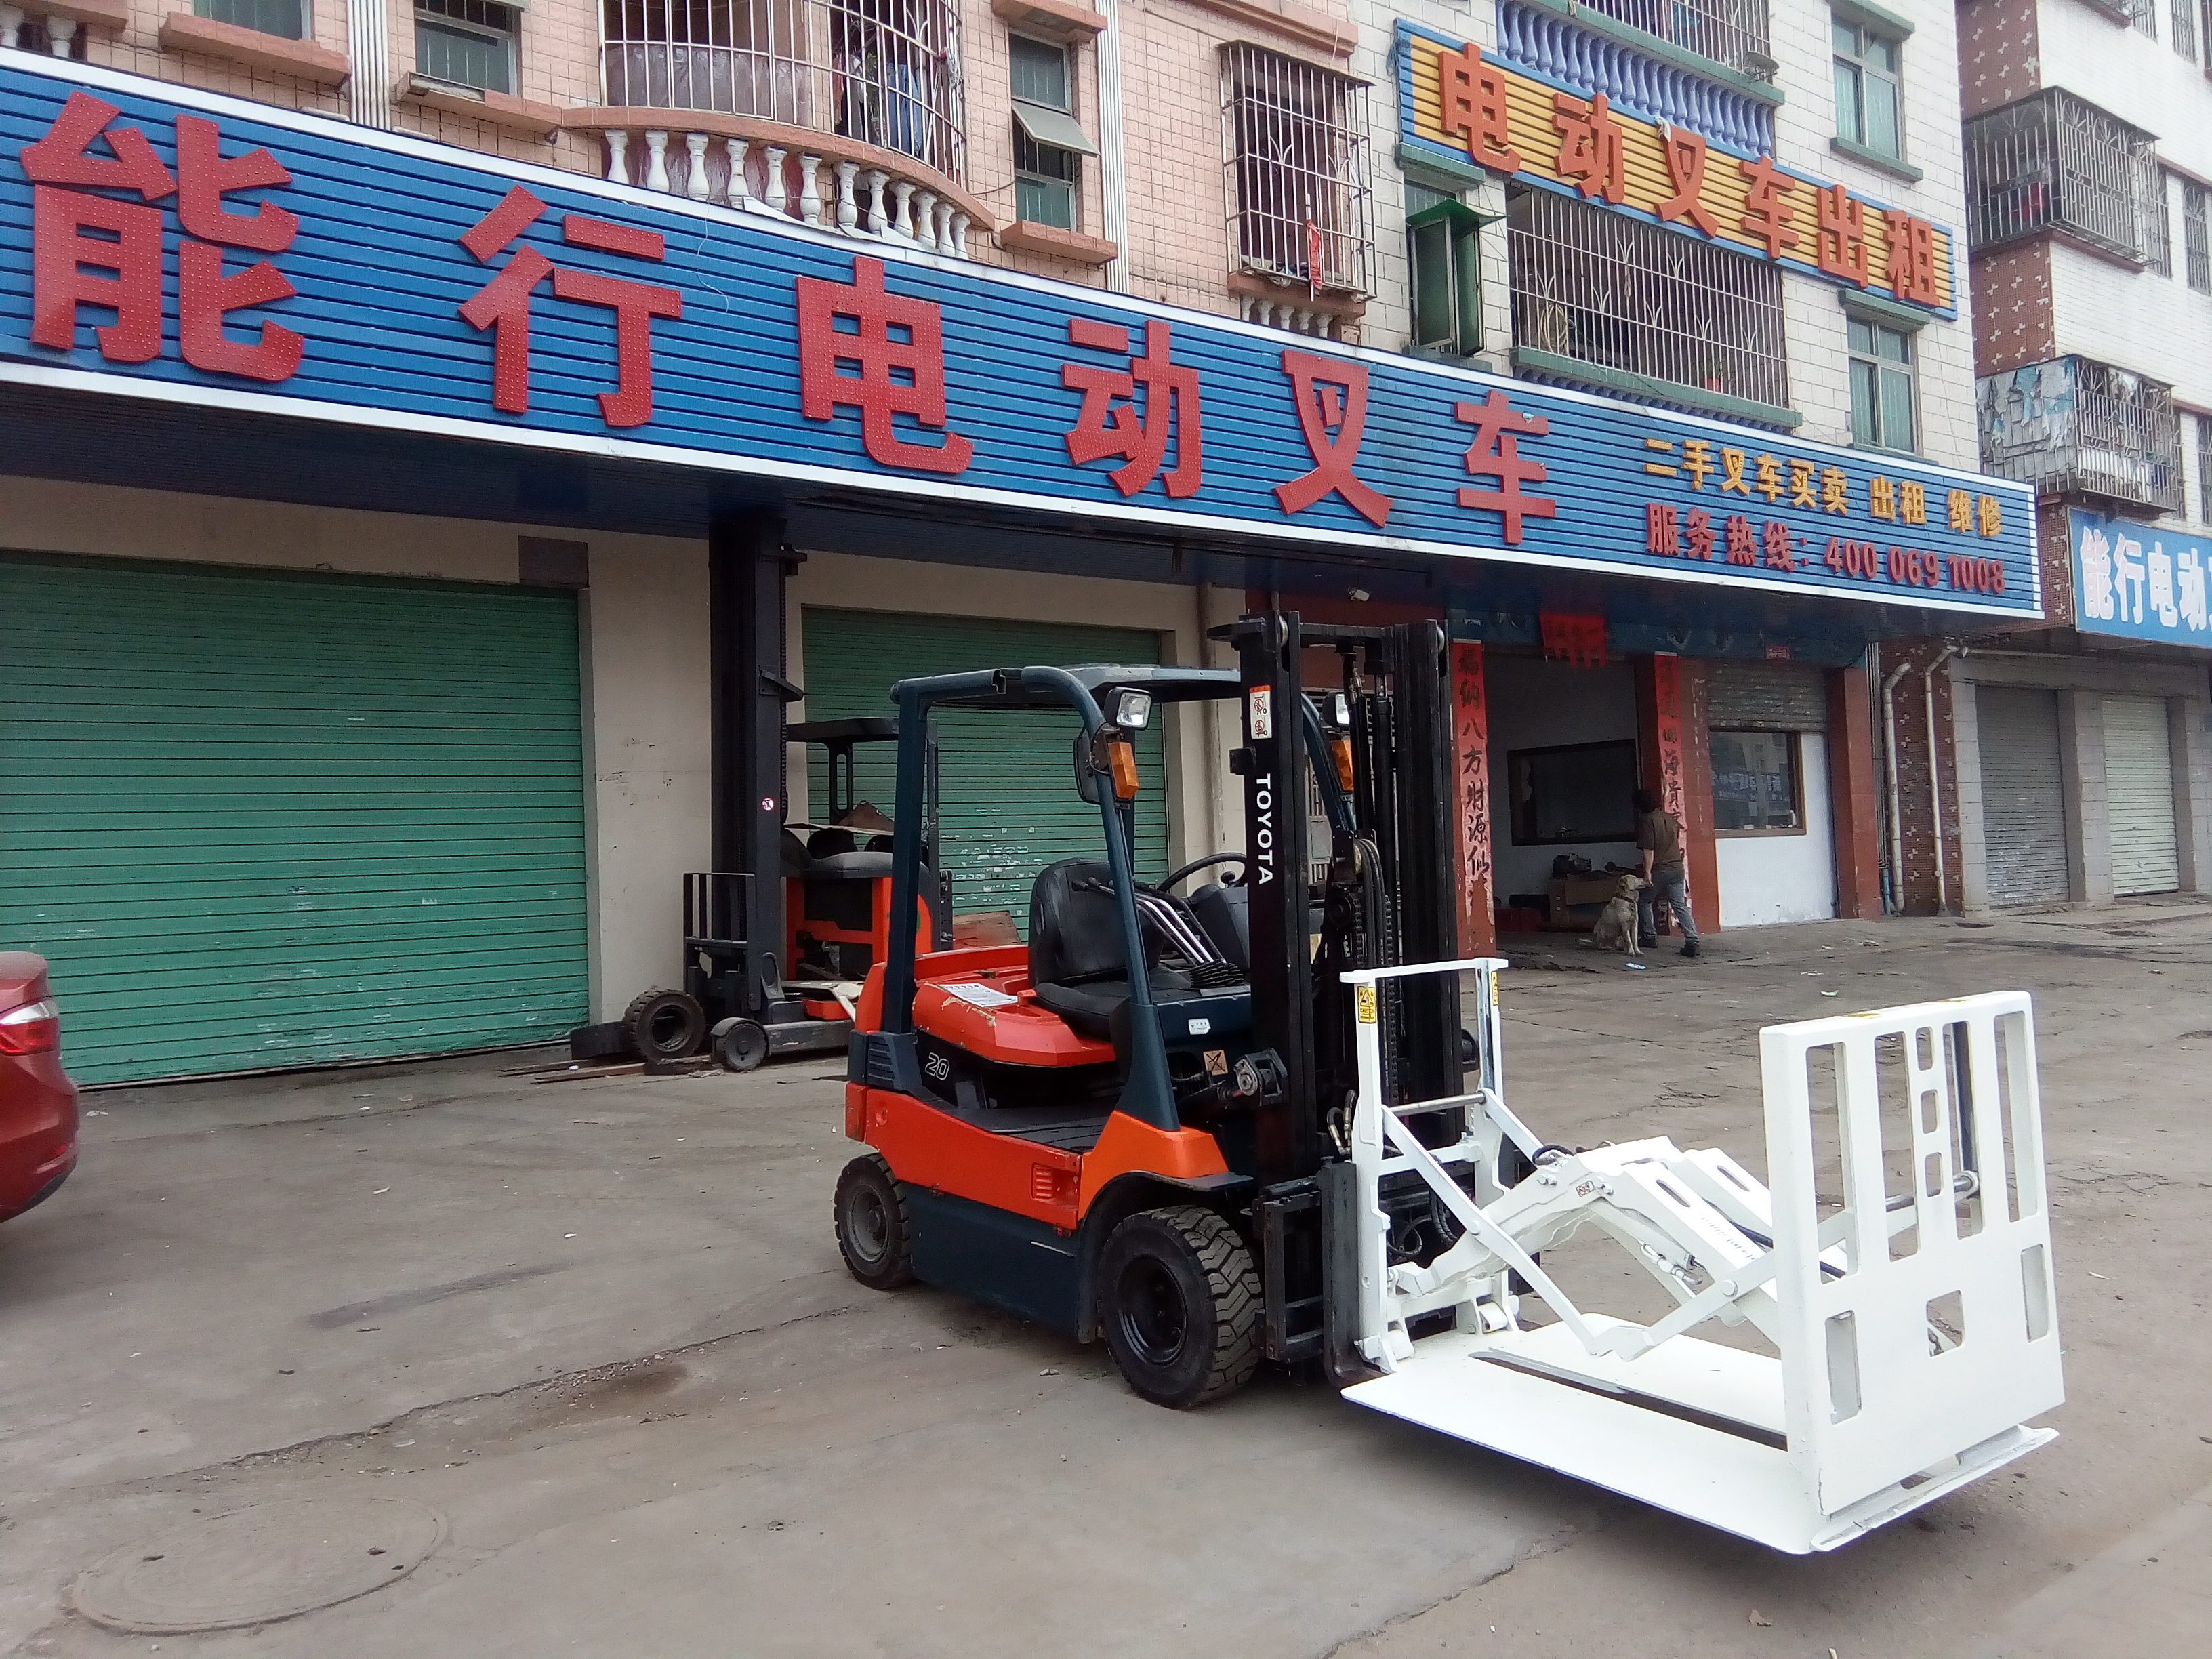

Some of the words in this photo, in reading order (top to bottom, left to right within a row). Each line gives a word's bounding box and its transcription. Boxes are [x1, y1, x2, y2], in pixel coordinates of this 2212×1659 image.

[1438, 43, 1940, 308] 电动叉车出租
[20, 90, 1556, 544] 能行电动叉车
[1643, 438, 1849, 516] 二手叉车买卖
[1870, 475, 1926, 525] 出租
[1947, 489, 2002, 537] 维修
[1824, 537, 1878, 579] 400
[1887, 546, 1940, 588] 069
[1946, 554, 2006, 594] 1008
[2080, 525, 2212, 632] 能行电动
[1256, 773, 1273, 885] TOYOTA
[925, 1052, 950, 1080] 20
